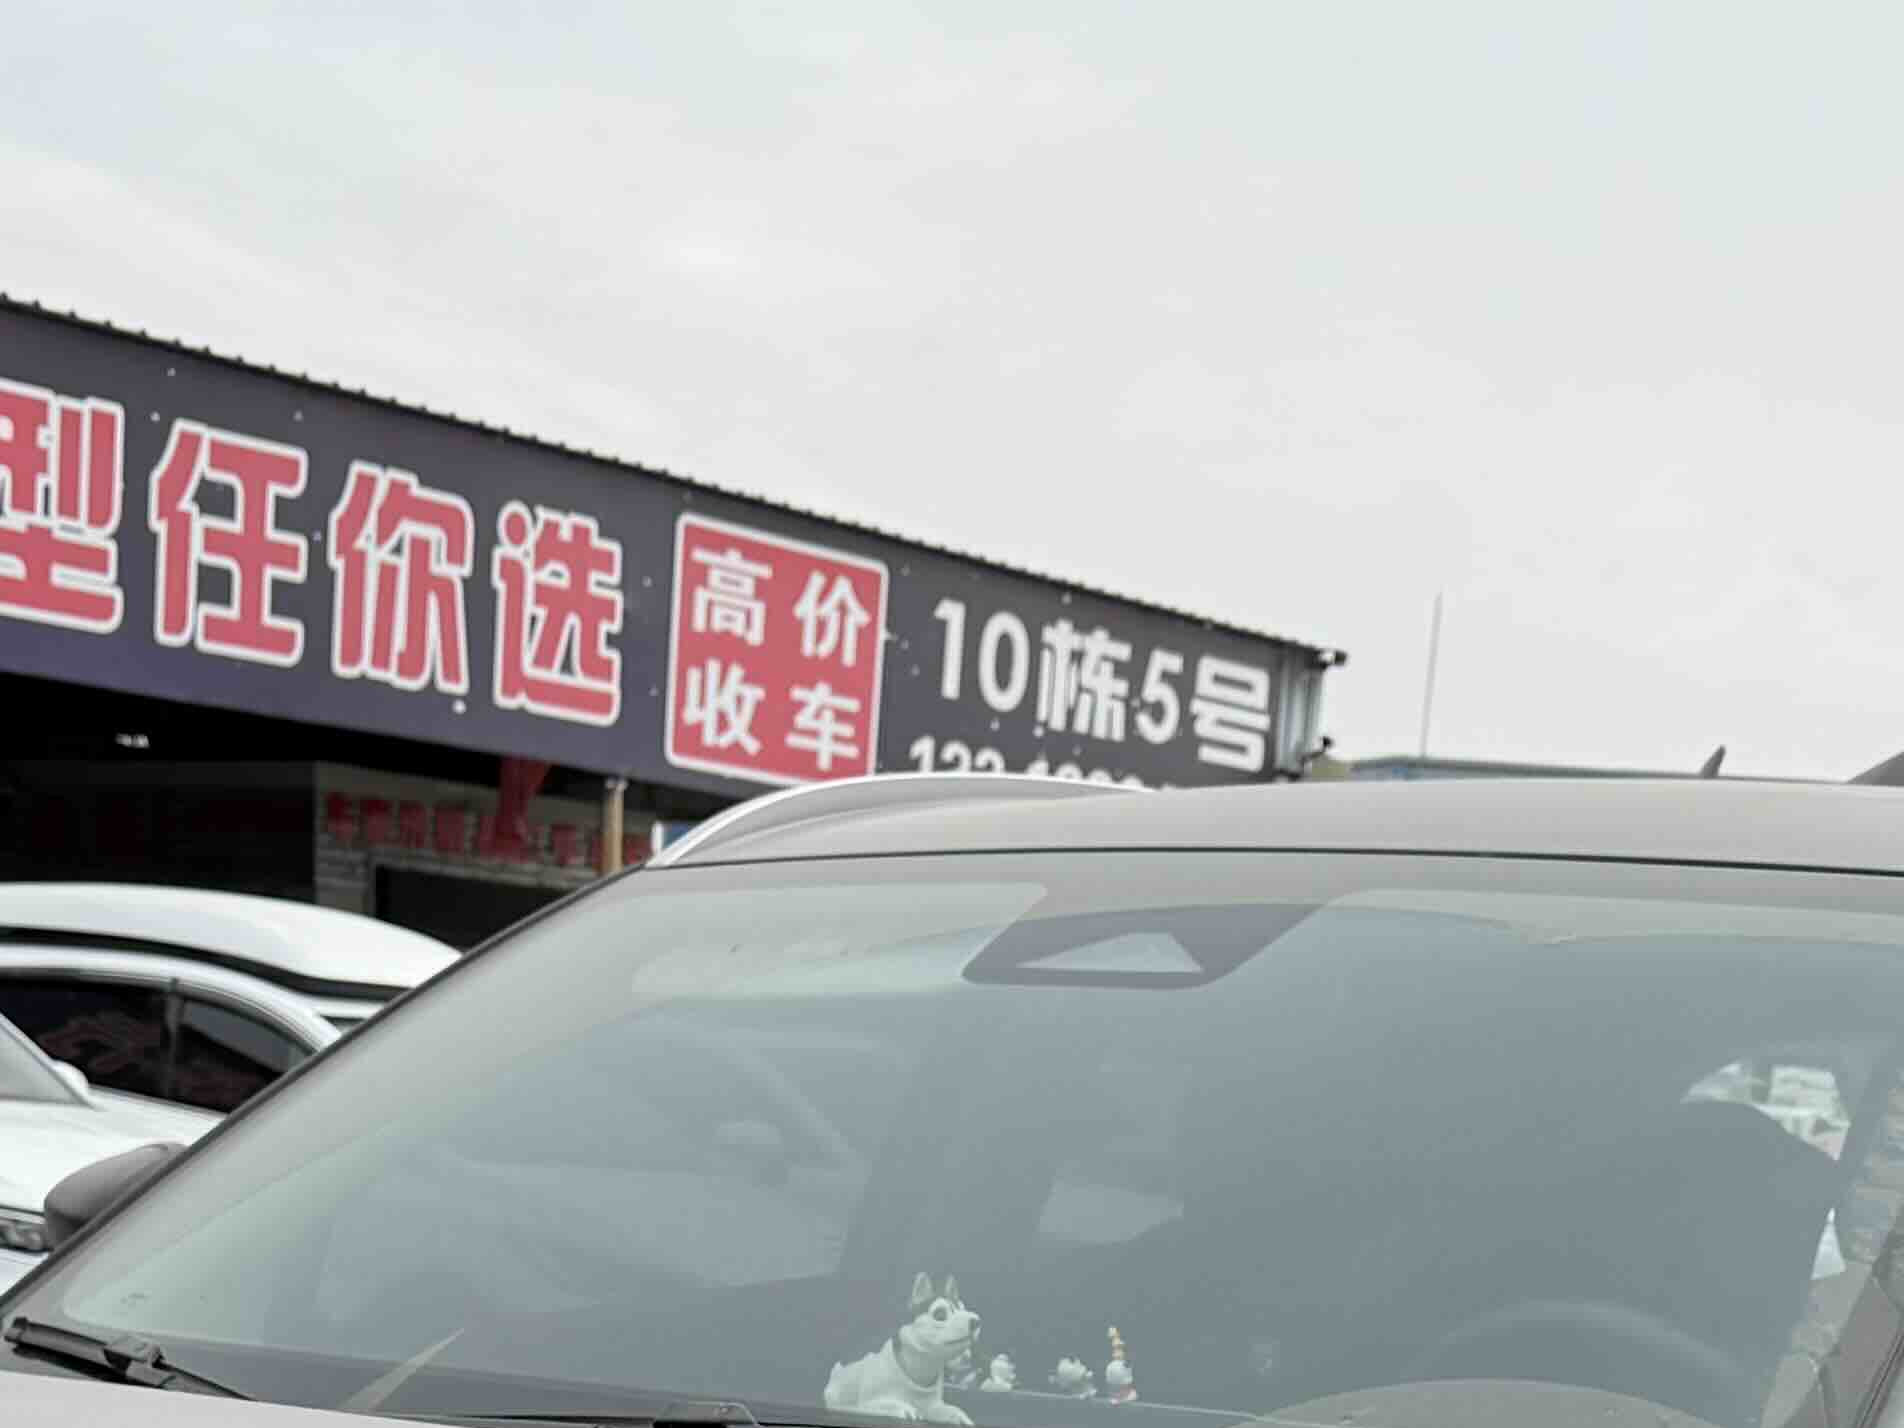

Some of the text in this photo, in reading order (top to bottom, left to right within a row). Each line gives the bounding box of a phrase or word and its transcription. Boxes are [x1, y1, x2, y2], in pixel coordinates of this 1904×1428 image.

[691, 547, 871, 669] 高价
[683, 657, 861, 771] 收车
[934, 598, 1271, 773] 10栋5号
